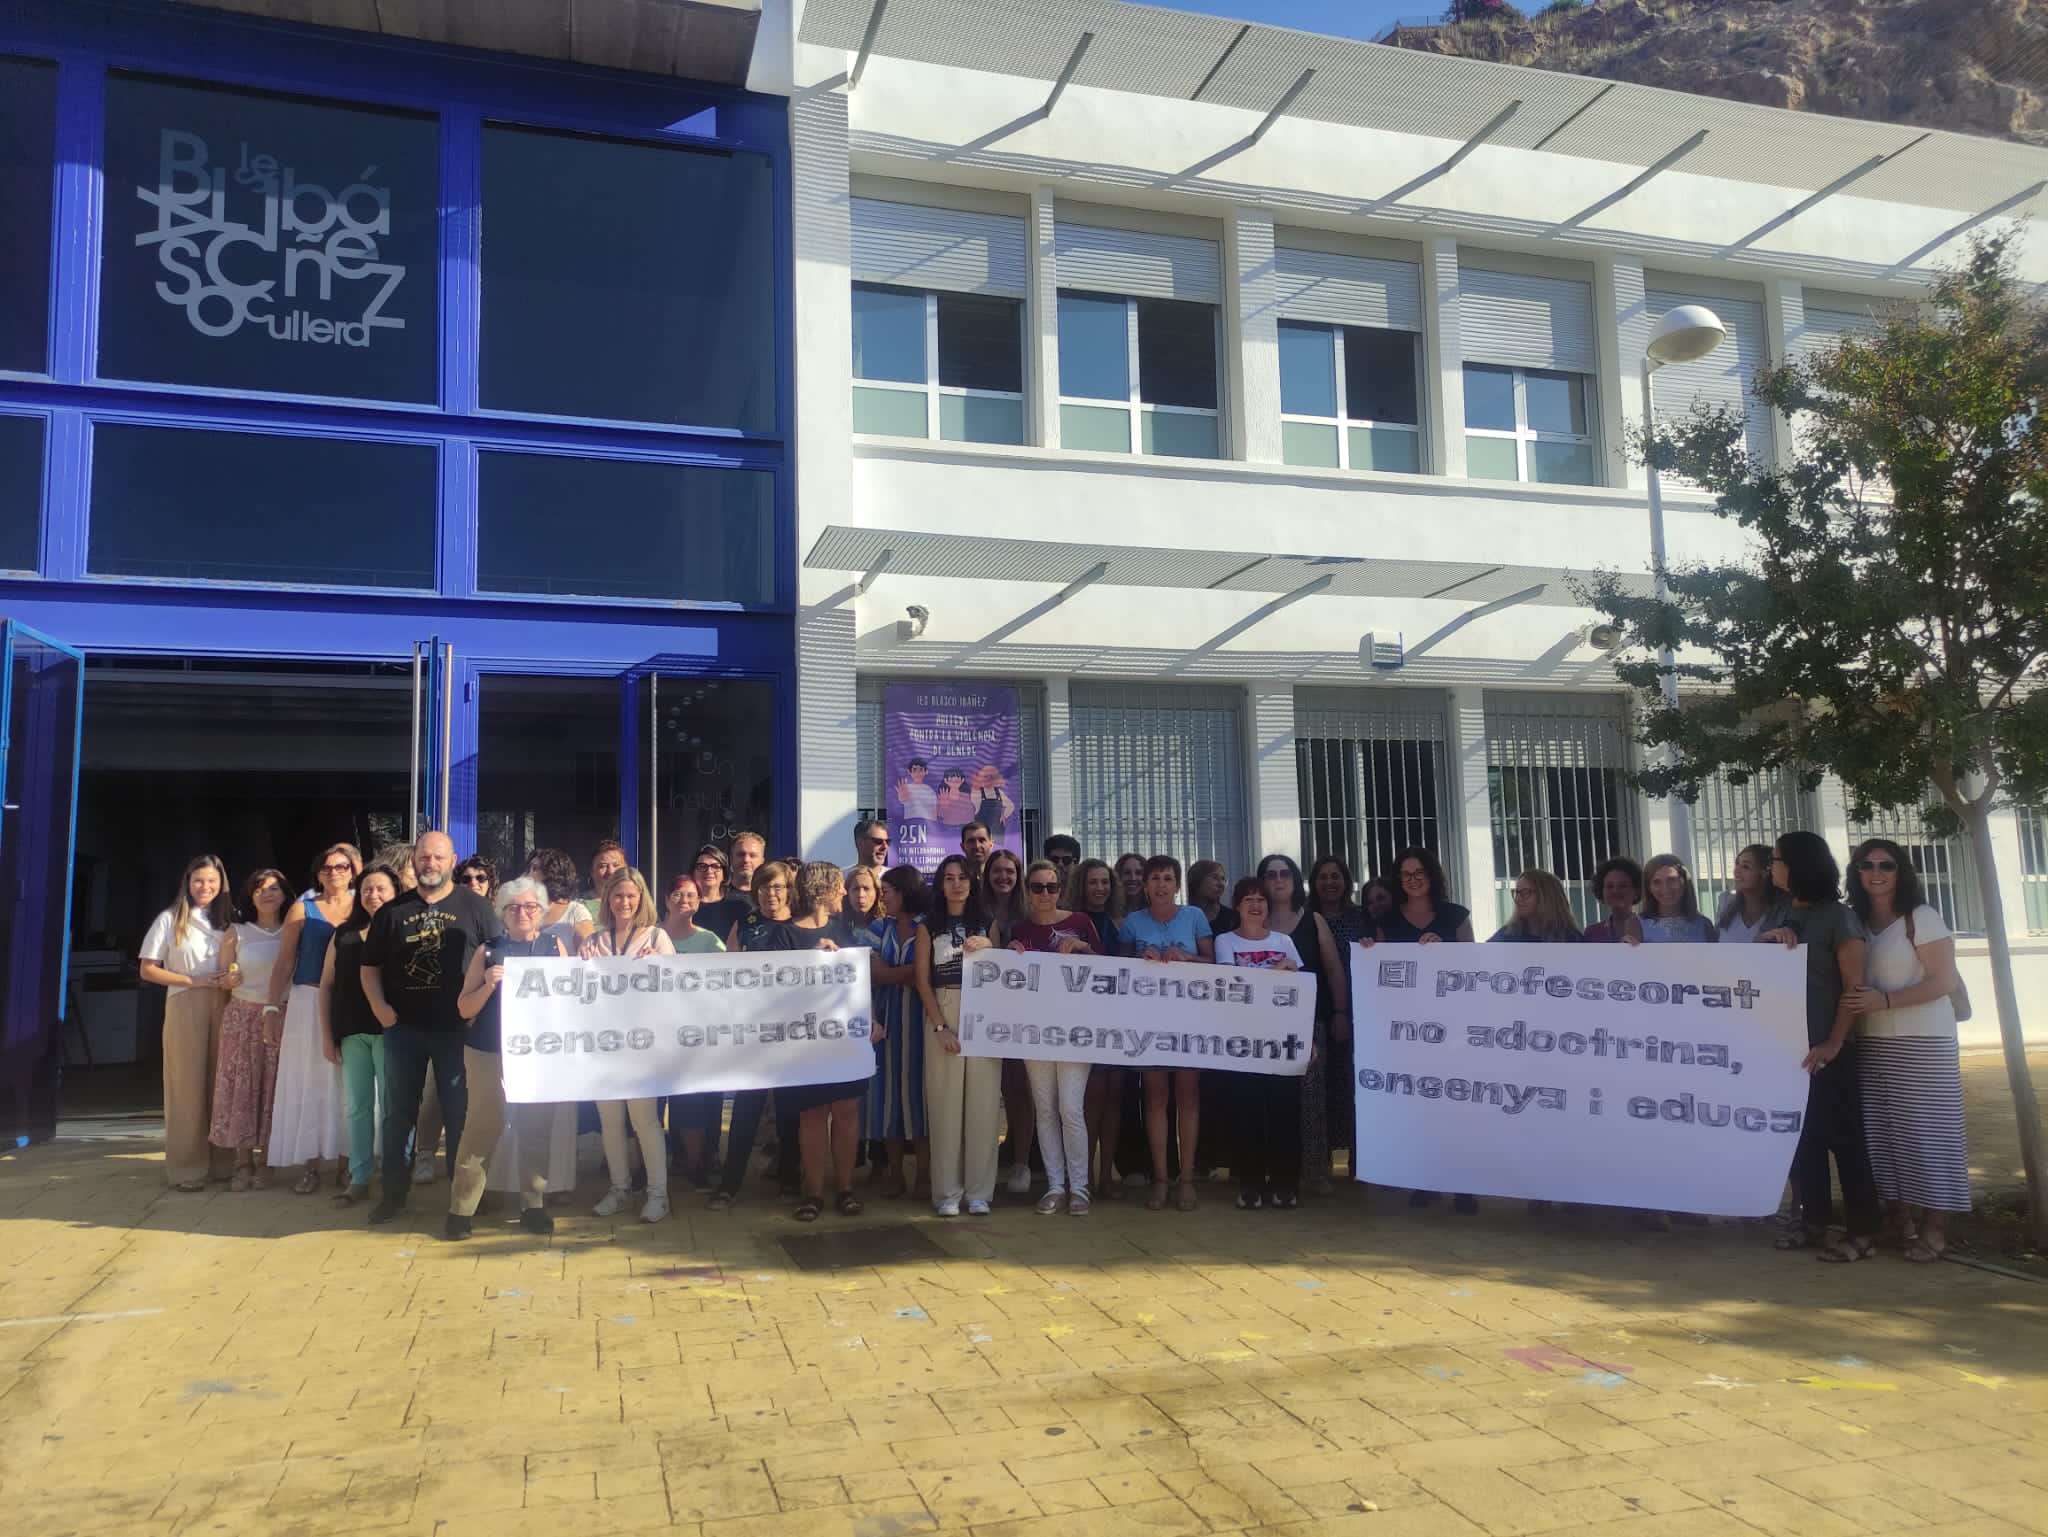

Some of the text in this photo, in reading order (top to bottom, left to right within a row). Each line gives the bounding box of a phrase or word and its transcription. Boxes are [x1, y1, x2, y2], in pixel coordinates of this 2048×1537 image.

[899, 823, 928, 844] 25N
[514, 960, 858, 1004] Adjudicacions
[971, 960, 1300, 1008] Pel Valencià a
[1377, 959, 1761, 1010] El professorat
[506, 1012, 871, 1057] sense errades
[962, 1012, 1305, 1061] l'ensenyament
[1389, 1019, 1744, 1075] no adoctrina,
[1358, 1068, 1802, 1135] ensenya i educa
